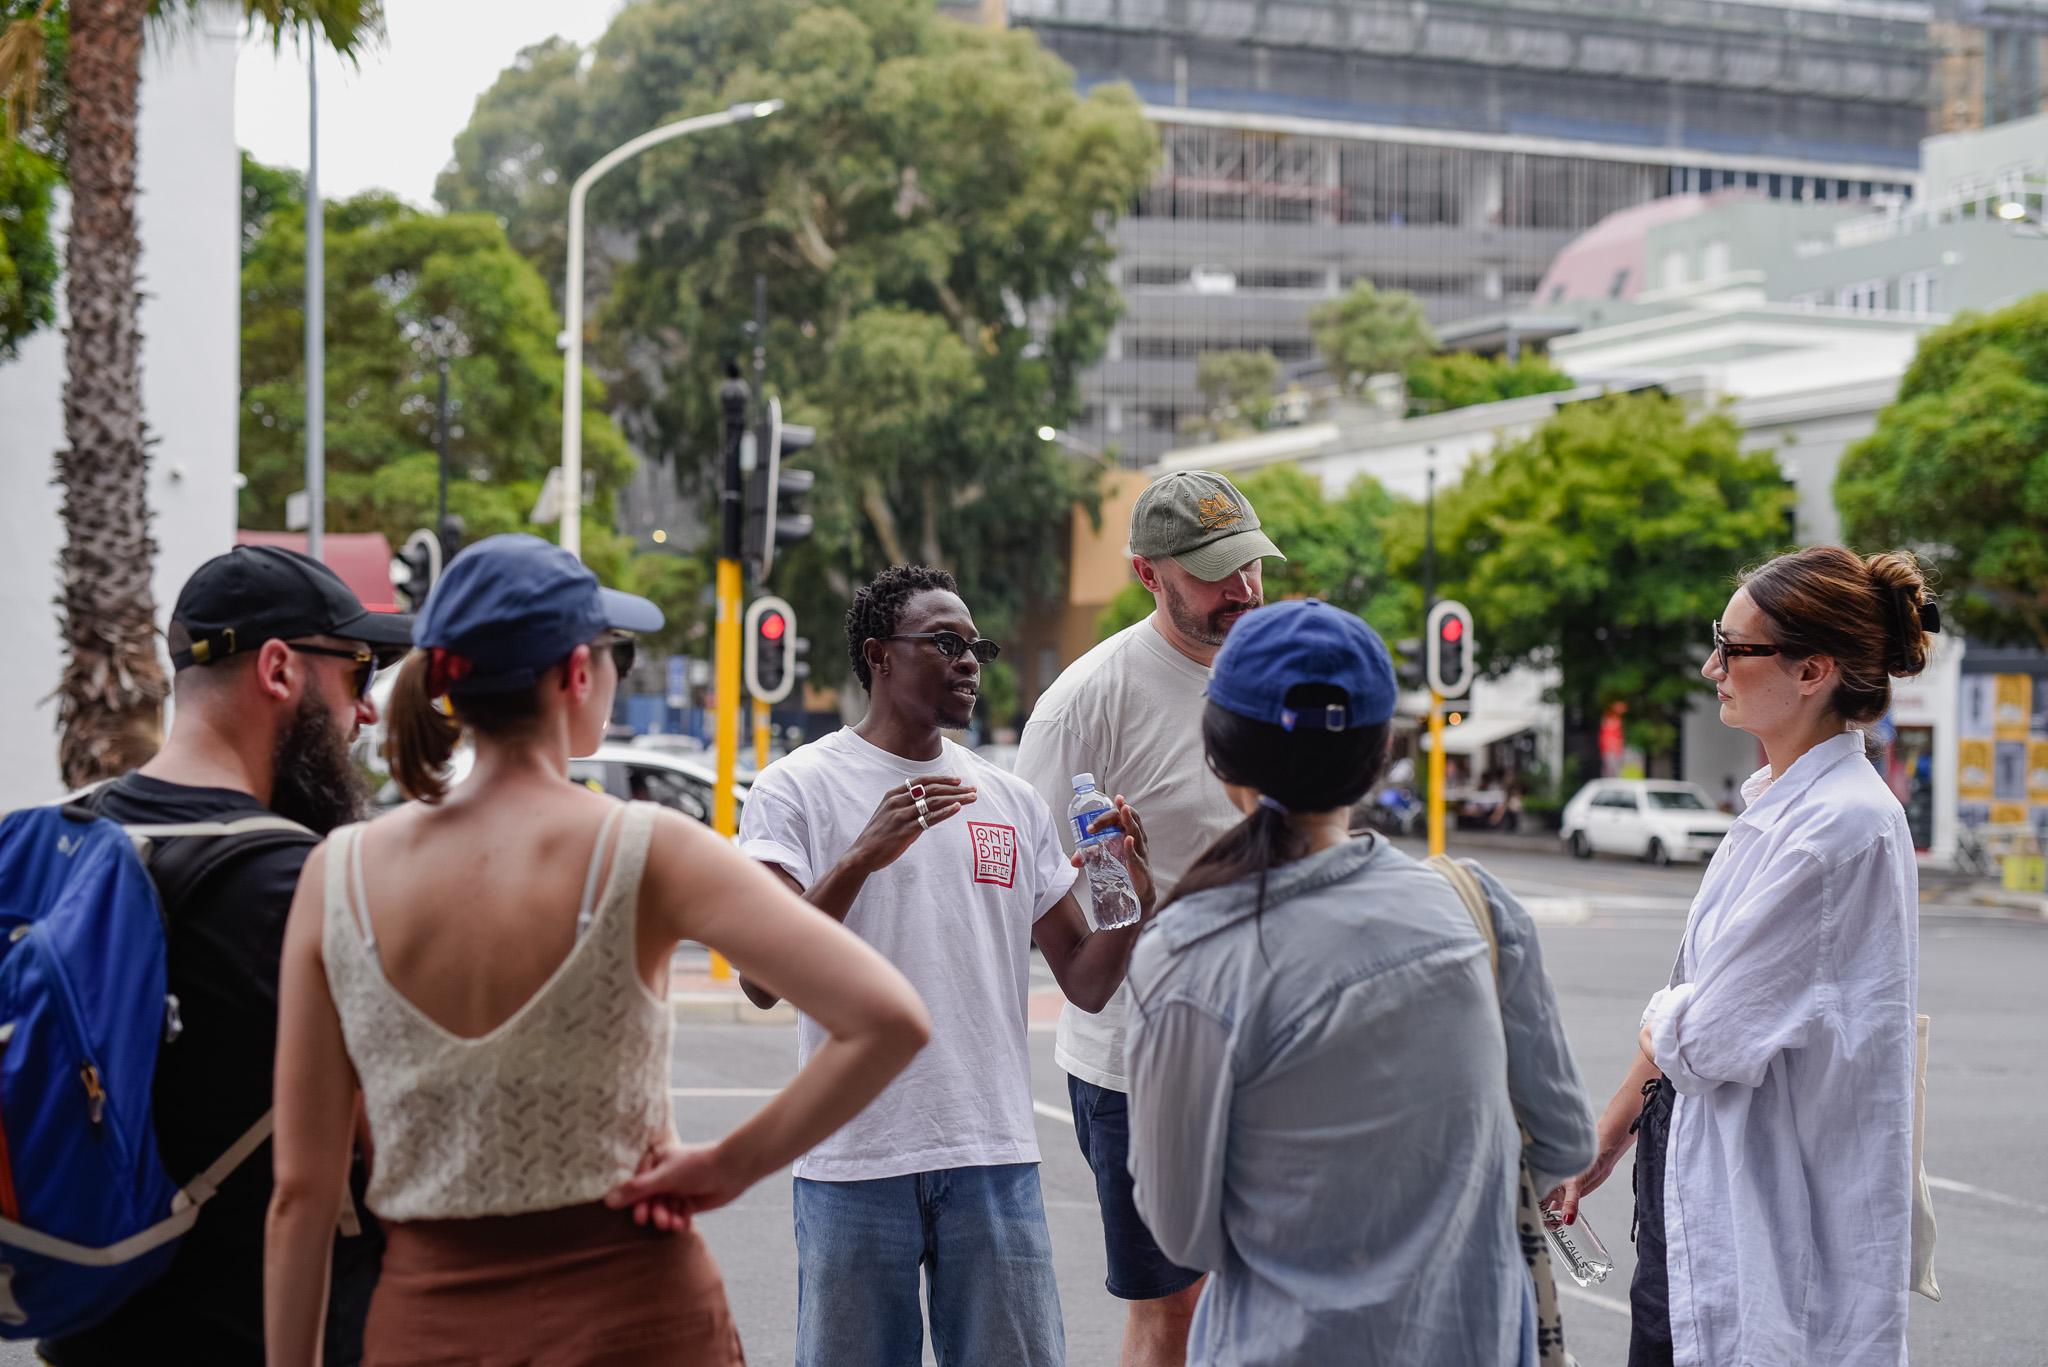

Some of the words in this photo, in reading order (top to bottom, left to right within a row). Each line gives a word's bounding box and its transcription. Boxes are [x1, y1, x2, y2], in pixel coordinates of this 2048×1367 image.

[976, 828, 1010, 846] ONE
[980, 844, 1010, 863] DAY
[980, 863, 1009, 877] AFRICA
[1564, 1239, 1588, 1269] FALLS
